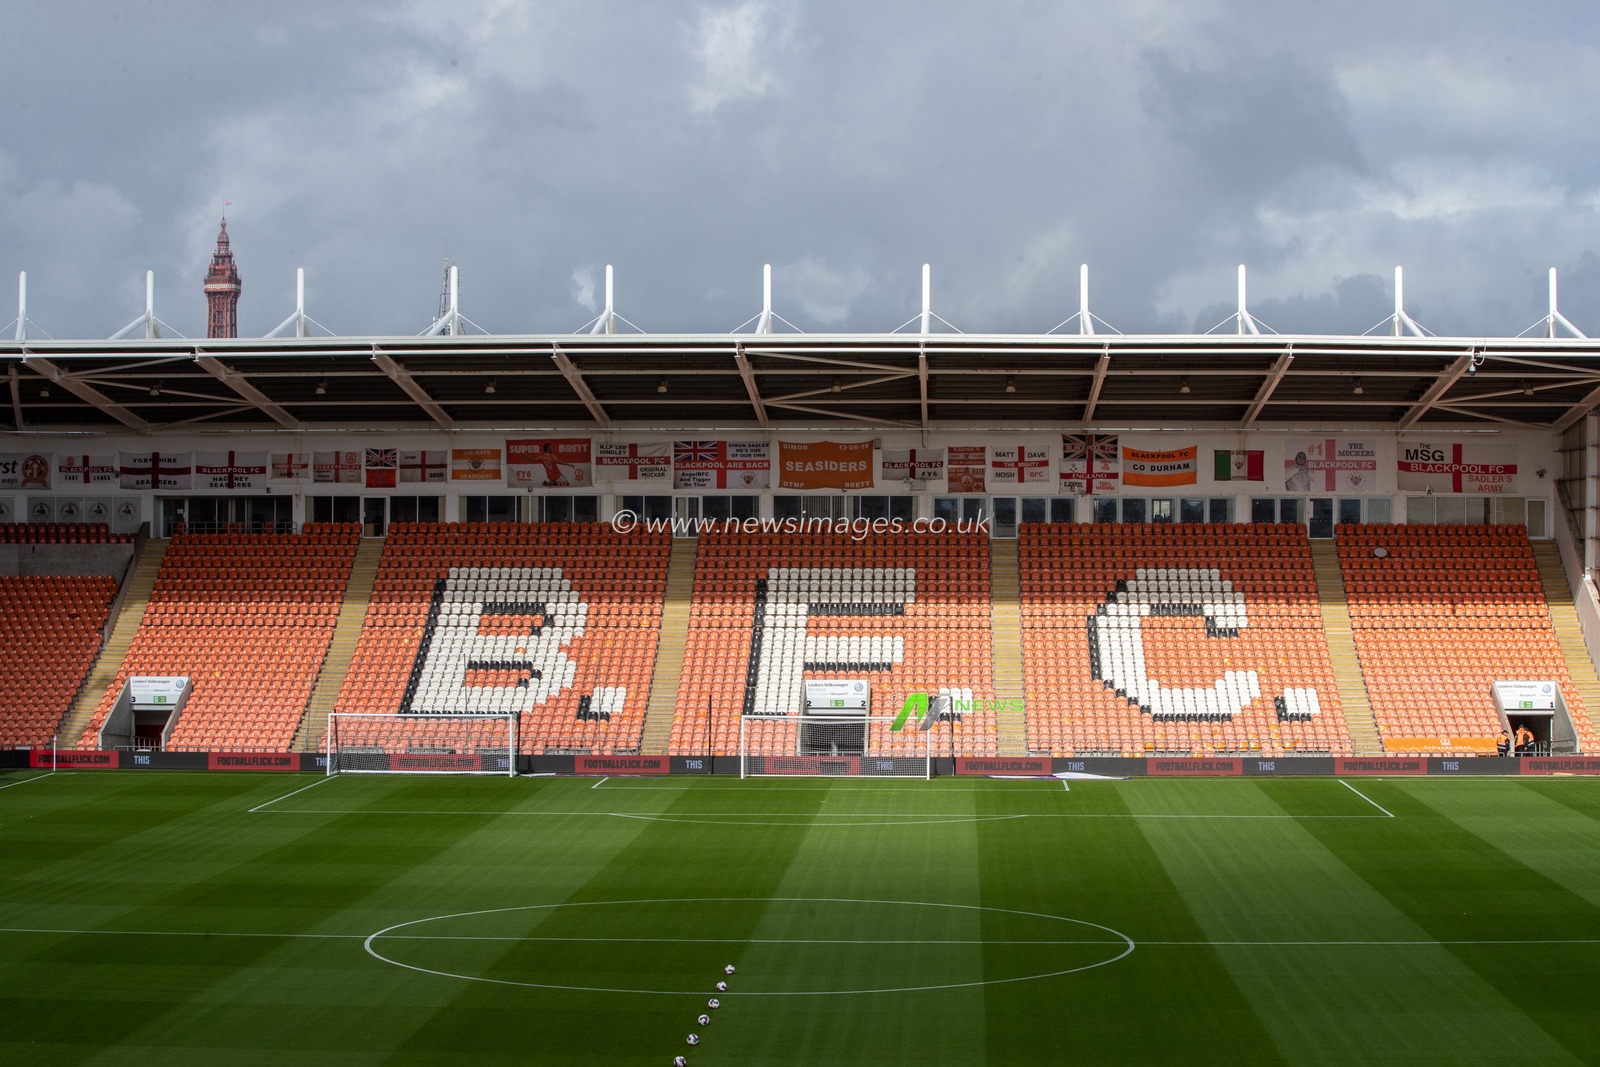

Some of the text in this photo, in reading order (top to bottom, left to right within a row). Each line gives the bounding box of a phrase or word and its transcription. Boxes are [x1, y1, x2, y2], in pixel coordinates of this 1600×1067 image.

[510, 444, 588, 453] SUPER BRETT
[1307, 444, 1323, 456] #1
[1405, 449, 1444, 462] MSG
[785, 461, 867, 471] SEASIDERS
[1151, 463, 1190, 472] DURHAM
[1411, 463, 1485, 473] BLACKPOOL
[38, 754, 110, 764] FOOTBALLFLICK.COM
[134, 755, 150, 764] THIS
[217, 757, 291, 766] FOOTBALLFLICK.COM
[316, 757, 330, 766] THI
[584, 760, 660, 769] FOOTBALLFLICK.COM
[686, 760, 702, 769] THIS
[876, 762, 893, 770] THIS
[965, 762, 1042, 770] FOOTBALLFLICK.COM
[1068, 762, 1085, 770] THIS
[1156, 762, 1233, 771] FOOTBALLFLICK.COM
[1258, 762, 1275, 771] THIS
[1343, 762, 1420, 771] FOOTBALLFLICK.COM
[1442, 762, 1459, 770] THIS
